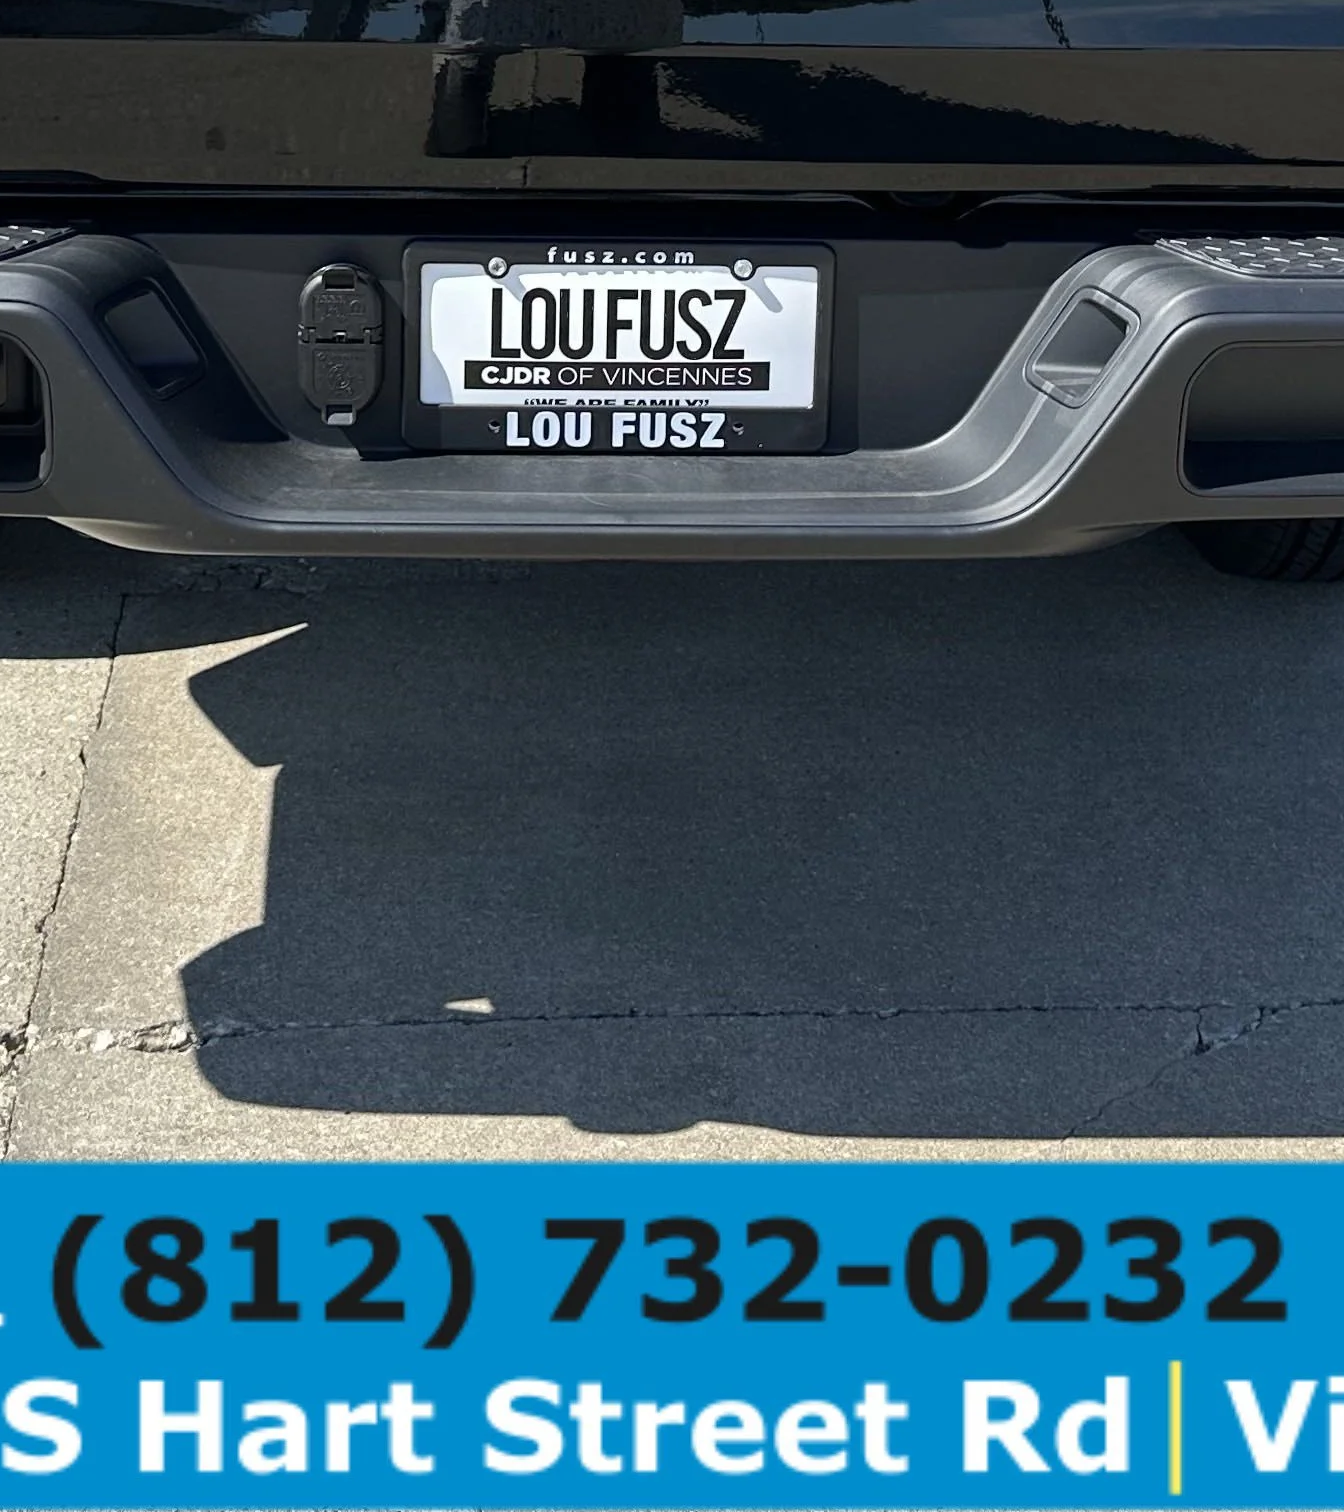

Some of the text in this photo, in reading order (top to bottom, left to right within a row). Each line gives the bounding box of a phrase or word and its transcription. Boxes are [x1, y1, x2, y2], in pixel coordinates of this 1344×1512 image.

[547, 246, 695, 265] fusz.com
[481, 366, 752, 386] CJDR OF VINCENNES
[505, 411, 727, 449] LOU FUSZ
